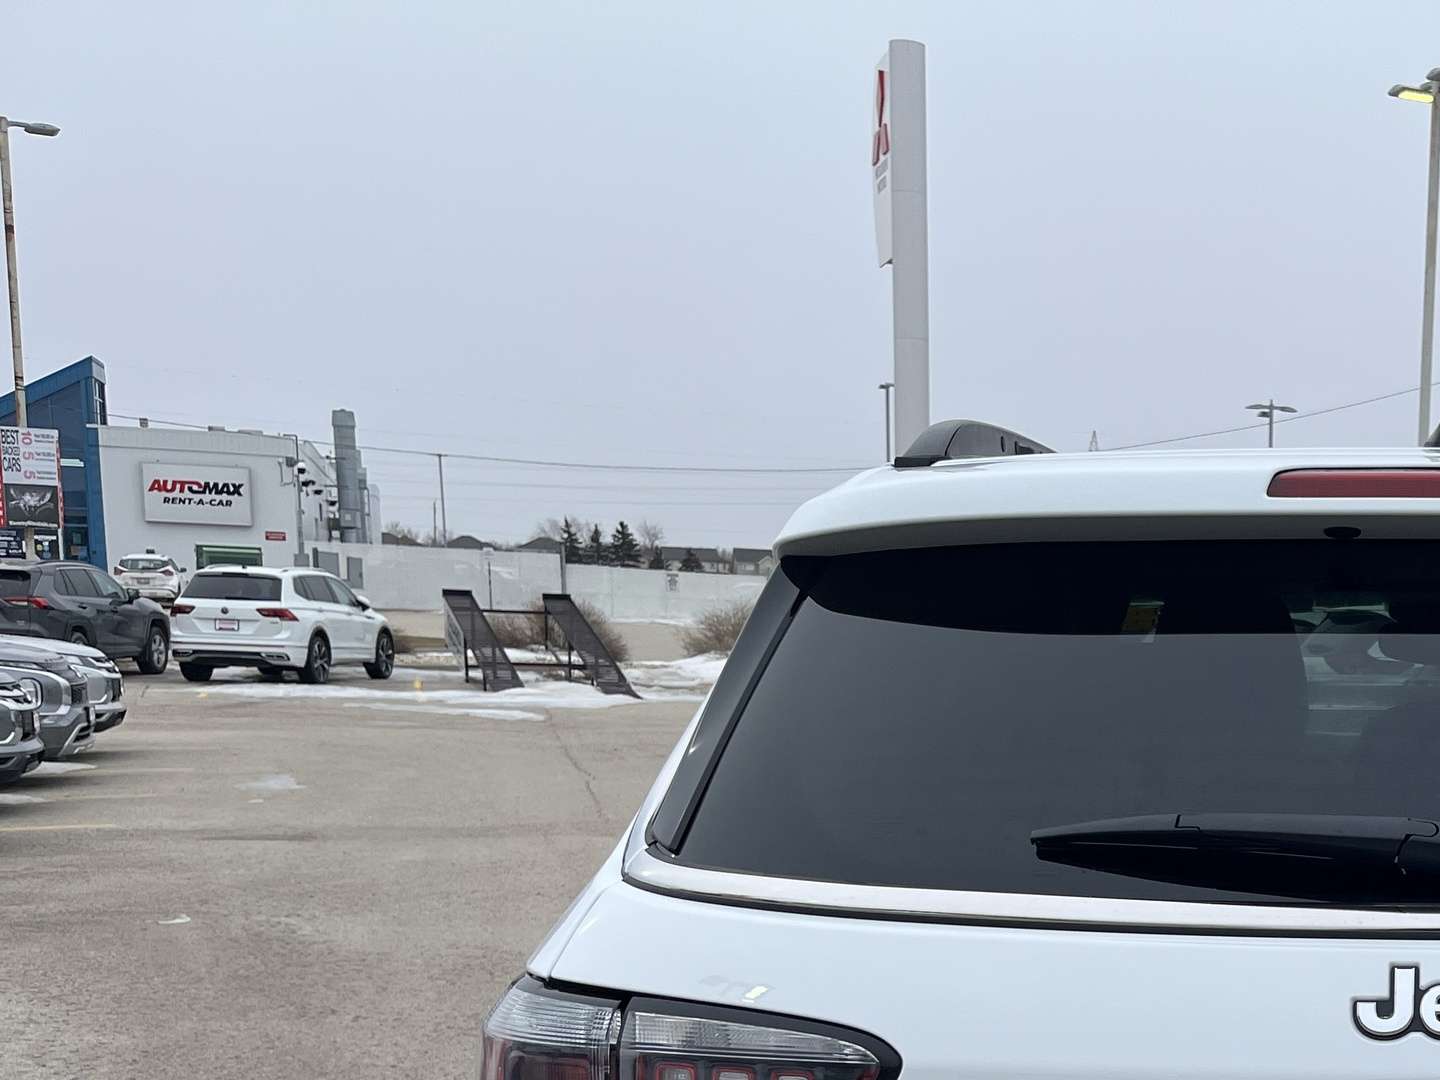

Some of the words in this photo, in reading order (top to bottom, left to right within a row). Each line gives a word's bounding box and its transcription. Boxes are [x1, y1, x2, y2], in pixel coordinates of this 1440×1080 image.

[1, 429, 19, 445] BEST
[3, 457, 21, 472] CARS
[148, 479, 244, 496] AUTOMAX
[162, 496, 233, 507] RENT-A-CAR
